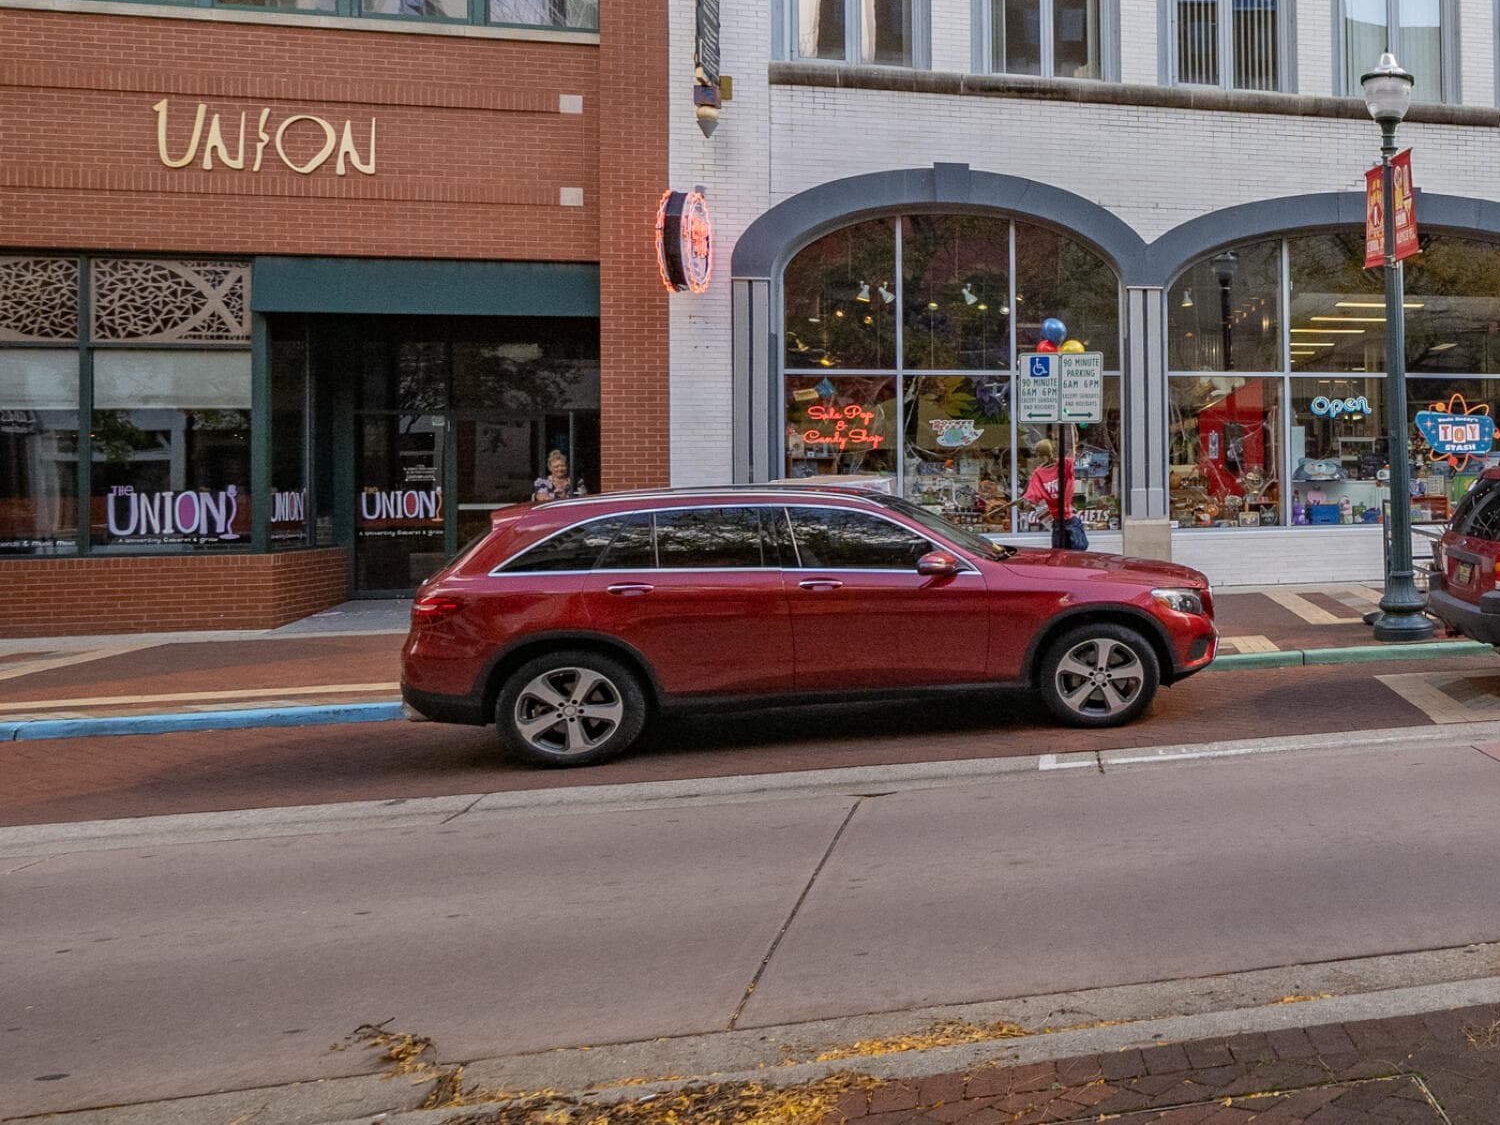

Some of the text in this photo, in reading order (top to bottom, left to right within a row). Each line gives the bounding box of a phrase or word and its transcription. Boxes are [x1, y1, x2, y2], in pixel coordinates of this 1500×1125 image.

[1064, 358, 1100, 367] 90 MINUTE
[1066, 369, 1096, 377] PARKING
[1022, 378, 1058, 387] 90 MINUTE
[1063, 379, 1099, 388] 6AM 6PM
[1022, 388, 1057, 396] 6AM 6PM
[1310, 395, 1373, 418] Open
[807, 404, 875, 426] Soda Pop
[835, 420, 848, 431] &
[1440, 424, 1479, 442] TOY
[803, 428, 884, 449] Candy Shop
[1445, 443, 1476, 451] STASH
